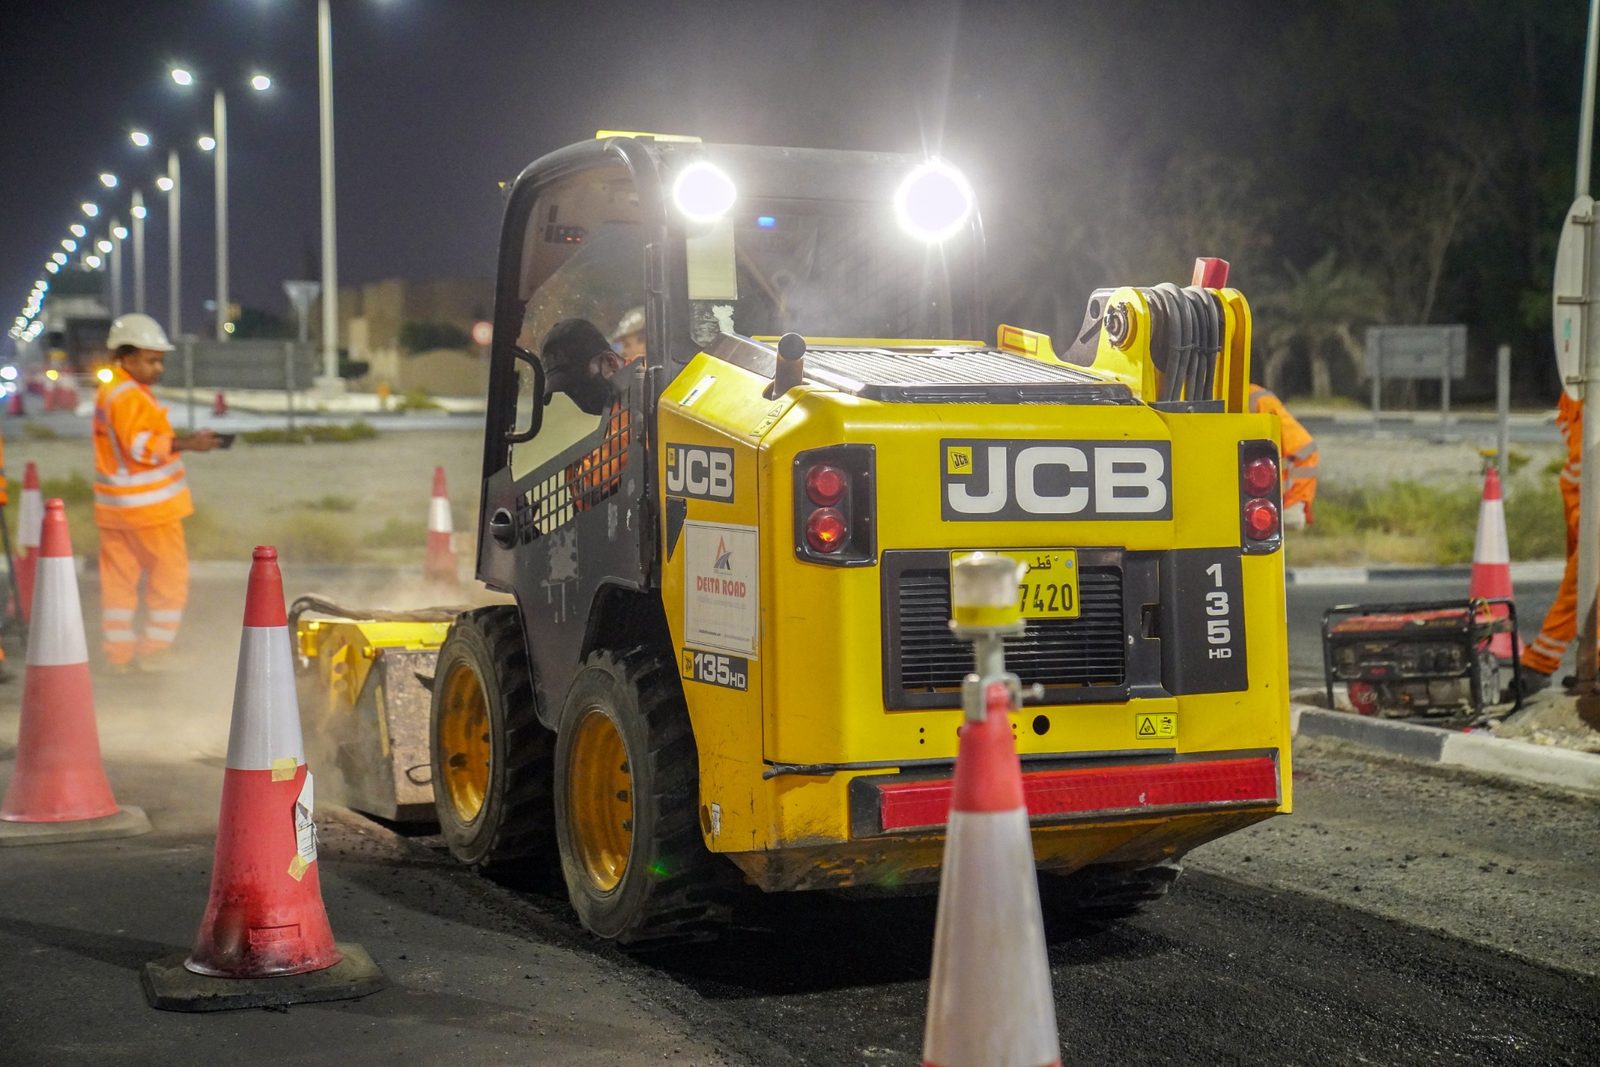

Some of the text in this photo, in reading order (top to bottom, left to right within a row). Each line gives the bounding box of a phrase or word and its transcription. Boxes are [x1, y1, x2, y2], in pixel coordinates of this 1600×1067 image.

[953, 452, 969, 468] JCB
[667, 448, 733, 498] JCB
[948, 447, 1167, 514] JCB
[1025, 554, 1051, 574] قطر
[696, 575, 747, 598] DELTA ROAD
